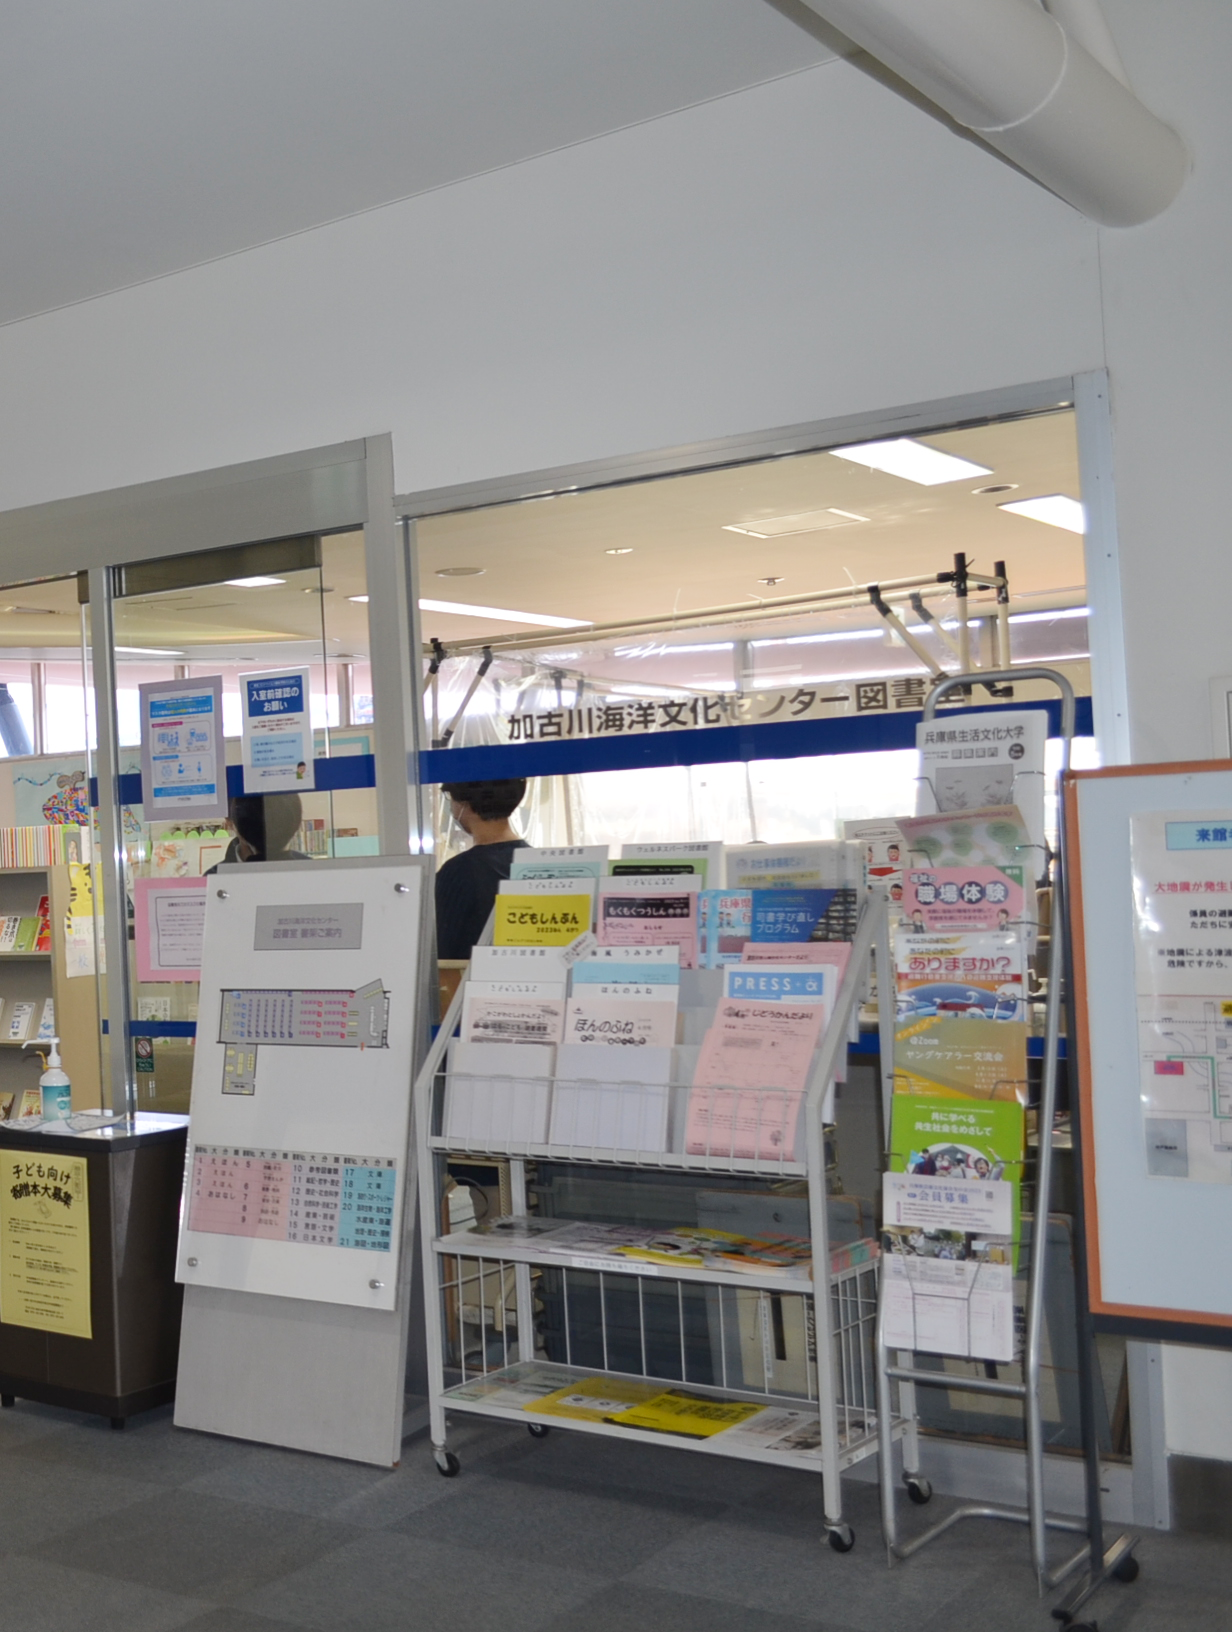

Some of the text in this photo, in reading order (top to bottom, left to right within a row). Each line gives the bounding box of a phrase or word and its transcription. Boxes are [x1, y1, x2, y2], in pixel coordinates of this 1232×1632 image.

[252, 687, 299, 701] 入室前確認の
[263, 700, 288, 712] お願い
[925, 726, 1025, 745] 兵庫県生活文化大学
[636, 844, 709, 853] ウェルネスパーク図書館
[909, 872, 937, 884] 福祉の
[917, 884, 1005, 903] 職場体験
[609, 907, 666, 916] もくもくつうしん
[506, 912, 579, 925] こどもしんぶん
[756, 912, 815, 923] 司書学び直し
[757, 924, 799, 933] プログラム
[492, 949, 546, 957] 加古川図書館
[909, 956, 1011, 973] ありますか？
[1168, 960, 1228, 969] 危険ですから、
[752, 1009, 813, 1020] じどうかんだより
[574, 1018, 634, 1034] ほんのふね
[909, 1036, 939, 1045] @Zoom
[906, 1050, 1003, 1062] ヤングケアラー交流会
[931, 1112, 976, 1124] 共に学べる
[915, 1121, 992, 1136] 共生社会をめざして
[211, 1158, 238, 1167] えほん
[293, 1164, 302, 1173] 10
[345, 1168, 354, 1176] 17
[12, 1162, 71, 1186] 子ども向け
[293, 1176, 302, 1184] 11
[344, 1180, 353, 1188] 18
[10, 1181, 74, 1209] 寄贈本大募集
[208, 1190, 235, 1200] おはなし
[292, 1187, 300, 1195] 12
[291, 1198, 299, 1206] 13
[919, 1190, 969, 1204] 会員募集
[342, 1203, 352, 1211] 20
[289, 1210, 298, 1218] 14
[288, 1221, 298, 1229] 15
[288, 1232, 333, 1244] 16 日本文学
[340, 1238, 349, 1246] 21
